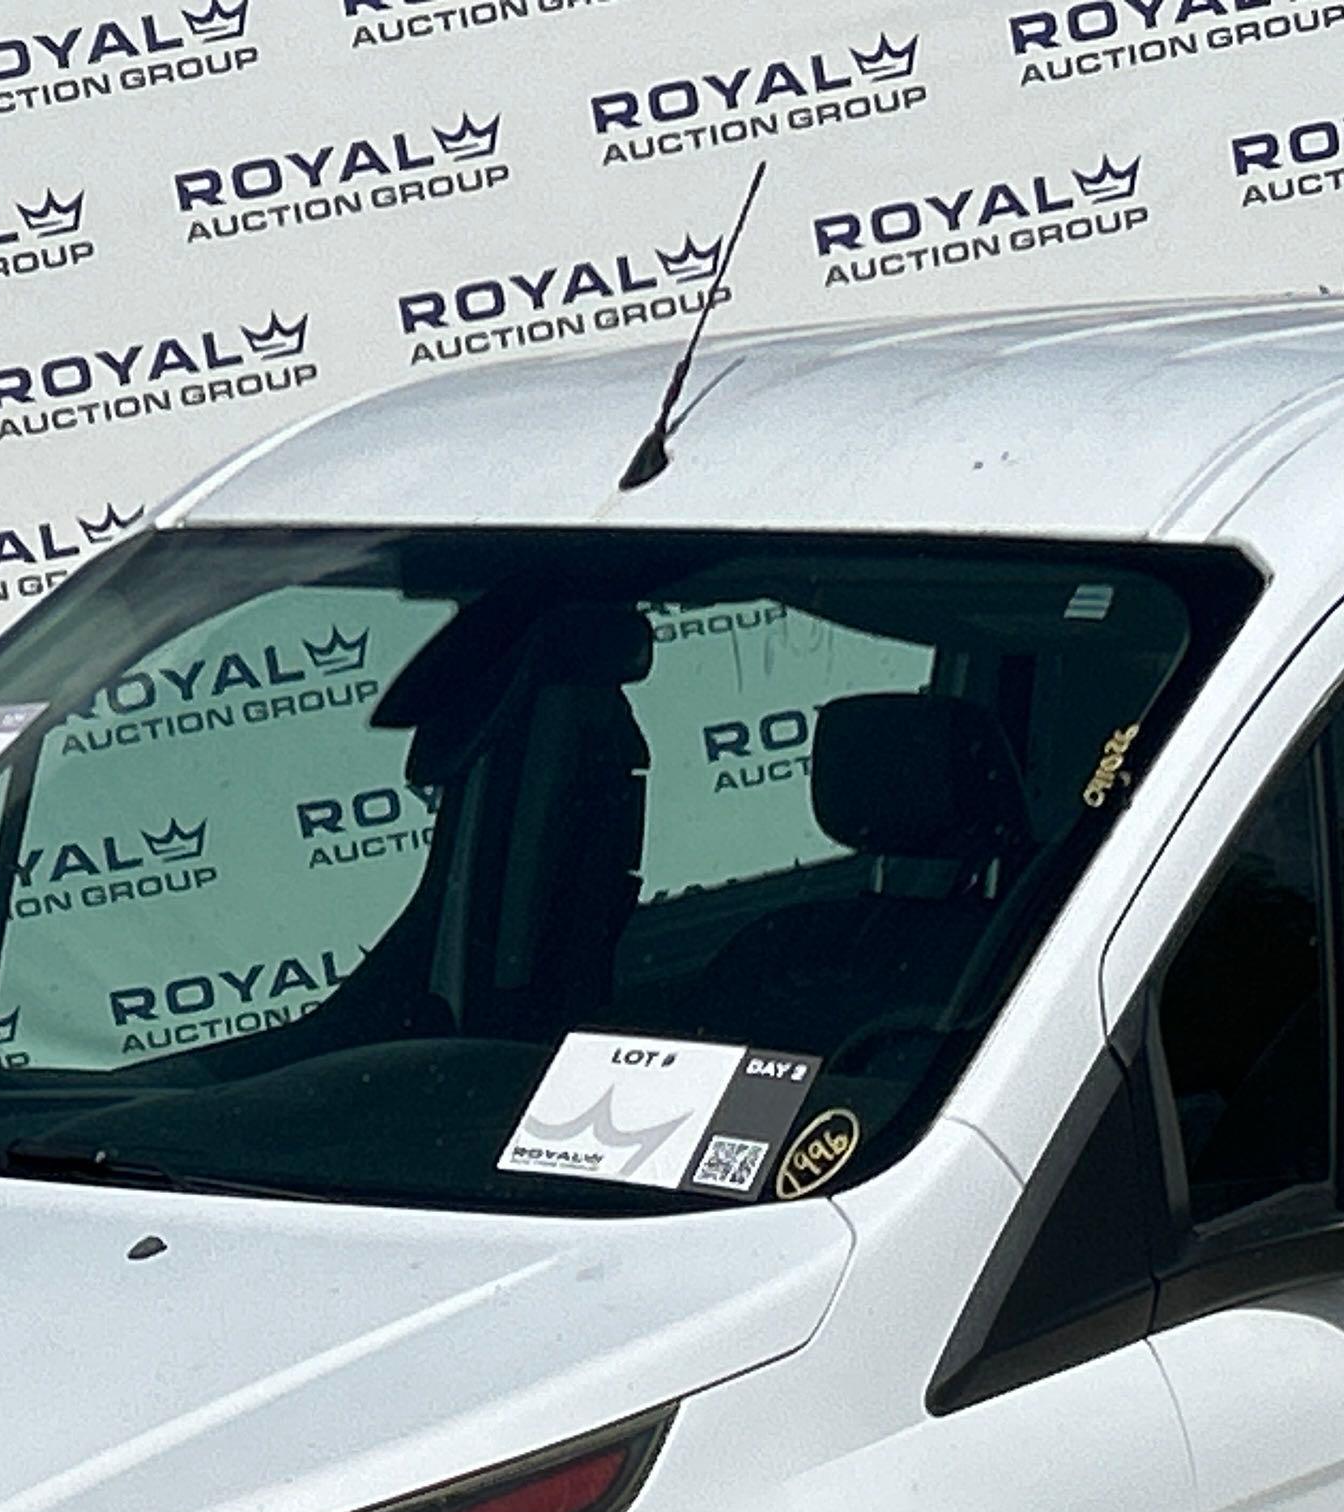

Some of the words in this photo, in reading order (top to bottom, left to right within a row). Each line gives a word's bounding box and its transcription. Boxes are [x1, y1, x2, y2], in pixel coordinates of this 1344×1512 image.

[352, 0, 529, 48] AUCTION
[120, 47, 258, 90] GROUP
[1021, 33, 1198, 87] AUCTION
[591, 54, 852, 134] ROYAL
[603, 113, 778, 166] AUCTION
[788, 85, 926, 130] GROUP
[175, 133, 435, 212] ROYAL
[188, 192, 362, 243] AUCTION
[372, 165, 509, 208] GROUP
[814, 176, 1074, 257] ROYAL
[825, 234, 1000, 288] AUCTION
[1011, 207, 1148, 251] GROUP
[399, 255, 657, 335] ROYAL
[411, 313, 585, 366] AUCTION
[595, 286, 732, 330] GROUP
[181, 364, 317, 406] GROUP
[62, 704, 235, 755] AUCTION
[242, 680, 378, 723] GROUP
[714, 756, 811, 793] AUCT
[309, 826, 433, 869] AUCTI
[82, 867, 217, 907] GROUP
[109, 951, 350, 1026] ROYAL
[121, 1003, 292, 1054] AUCTION
[612, 1046, 660, 1067] LOT
[745, 1058, 792, 1079] DAY
